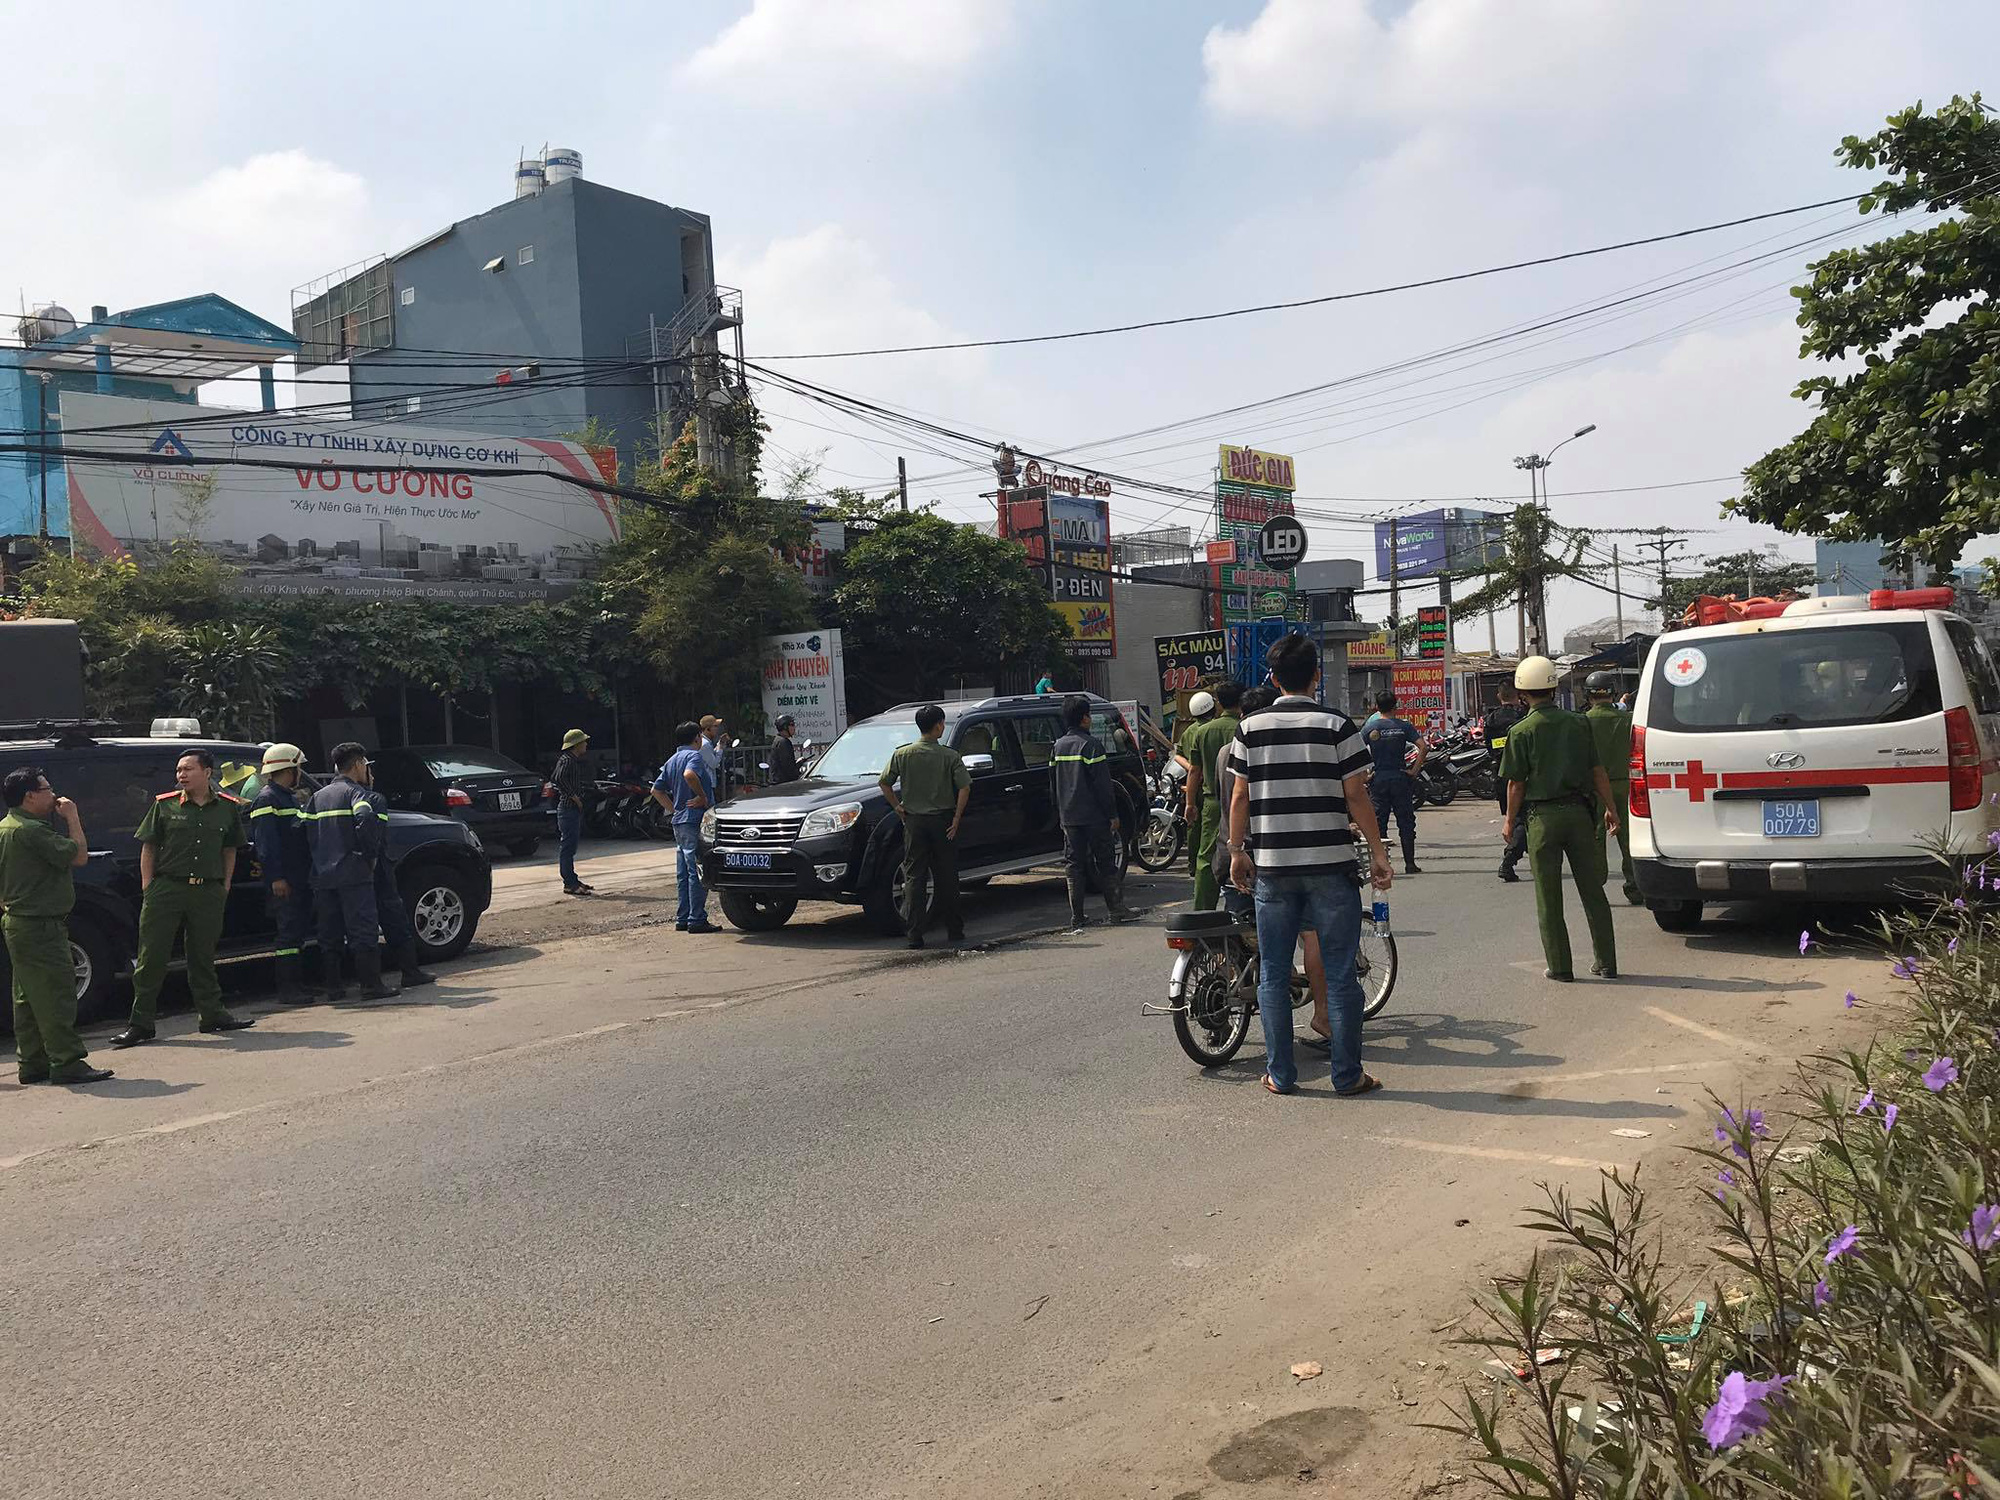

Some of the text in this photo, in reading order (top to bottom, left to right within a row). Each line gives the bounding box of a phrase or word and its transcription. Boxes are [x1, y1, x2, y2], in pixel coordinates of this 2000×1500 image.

[231, 425, 518, 465] CÔNG TY TNHH XÂY DỰNG CƠ KHÍ
[1228, 445, 1294, 488] ĐỨC GIA
[296, 459, 473, 500] VÕ CƯỜNG
[343, 501, 361, 514] Giá
[384, 504, 408, 517] Hiện
[410, 505, 436, 519] Thực
[438, 507, 459, 519] Ước
[1262, 528, 1301, 556] LED
[1383, 530, 1435, 549] NvaWorld
[1069, 573, 1103, 598] ĐÈN
[1158, 636, 1224, 657] SẮC MÀU
[1204, 653, 1225, 671] 94
[1162, 658, 1200, 691] in
[1414, 696, 1443, 709] DECAL
[1776, 803, 1805, 818] 50A
[1765, 818, 1816, 834] 007.79
